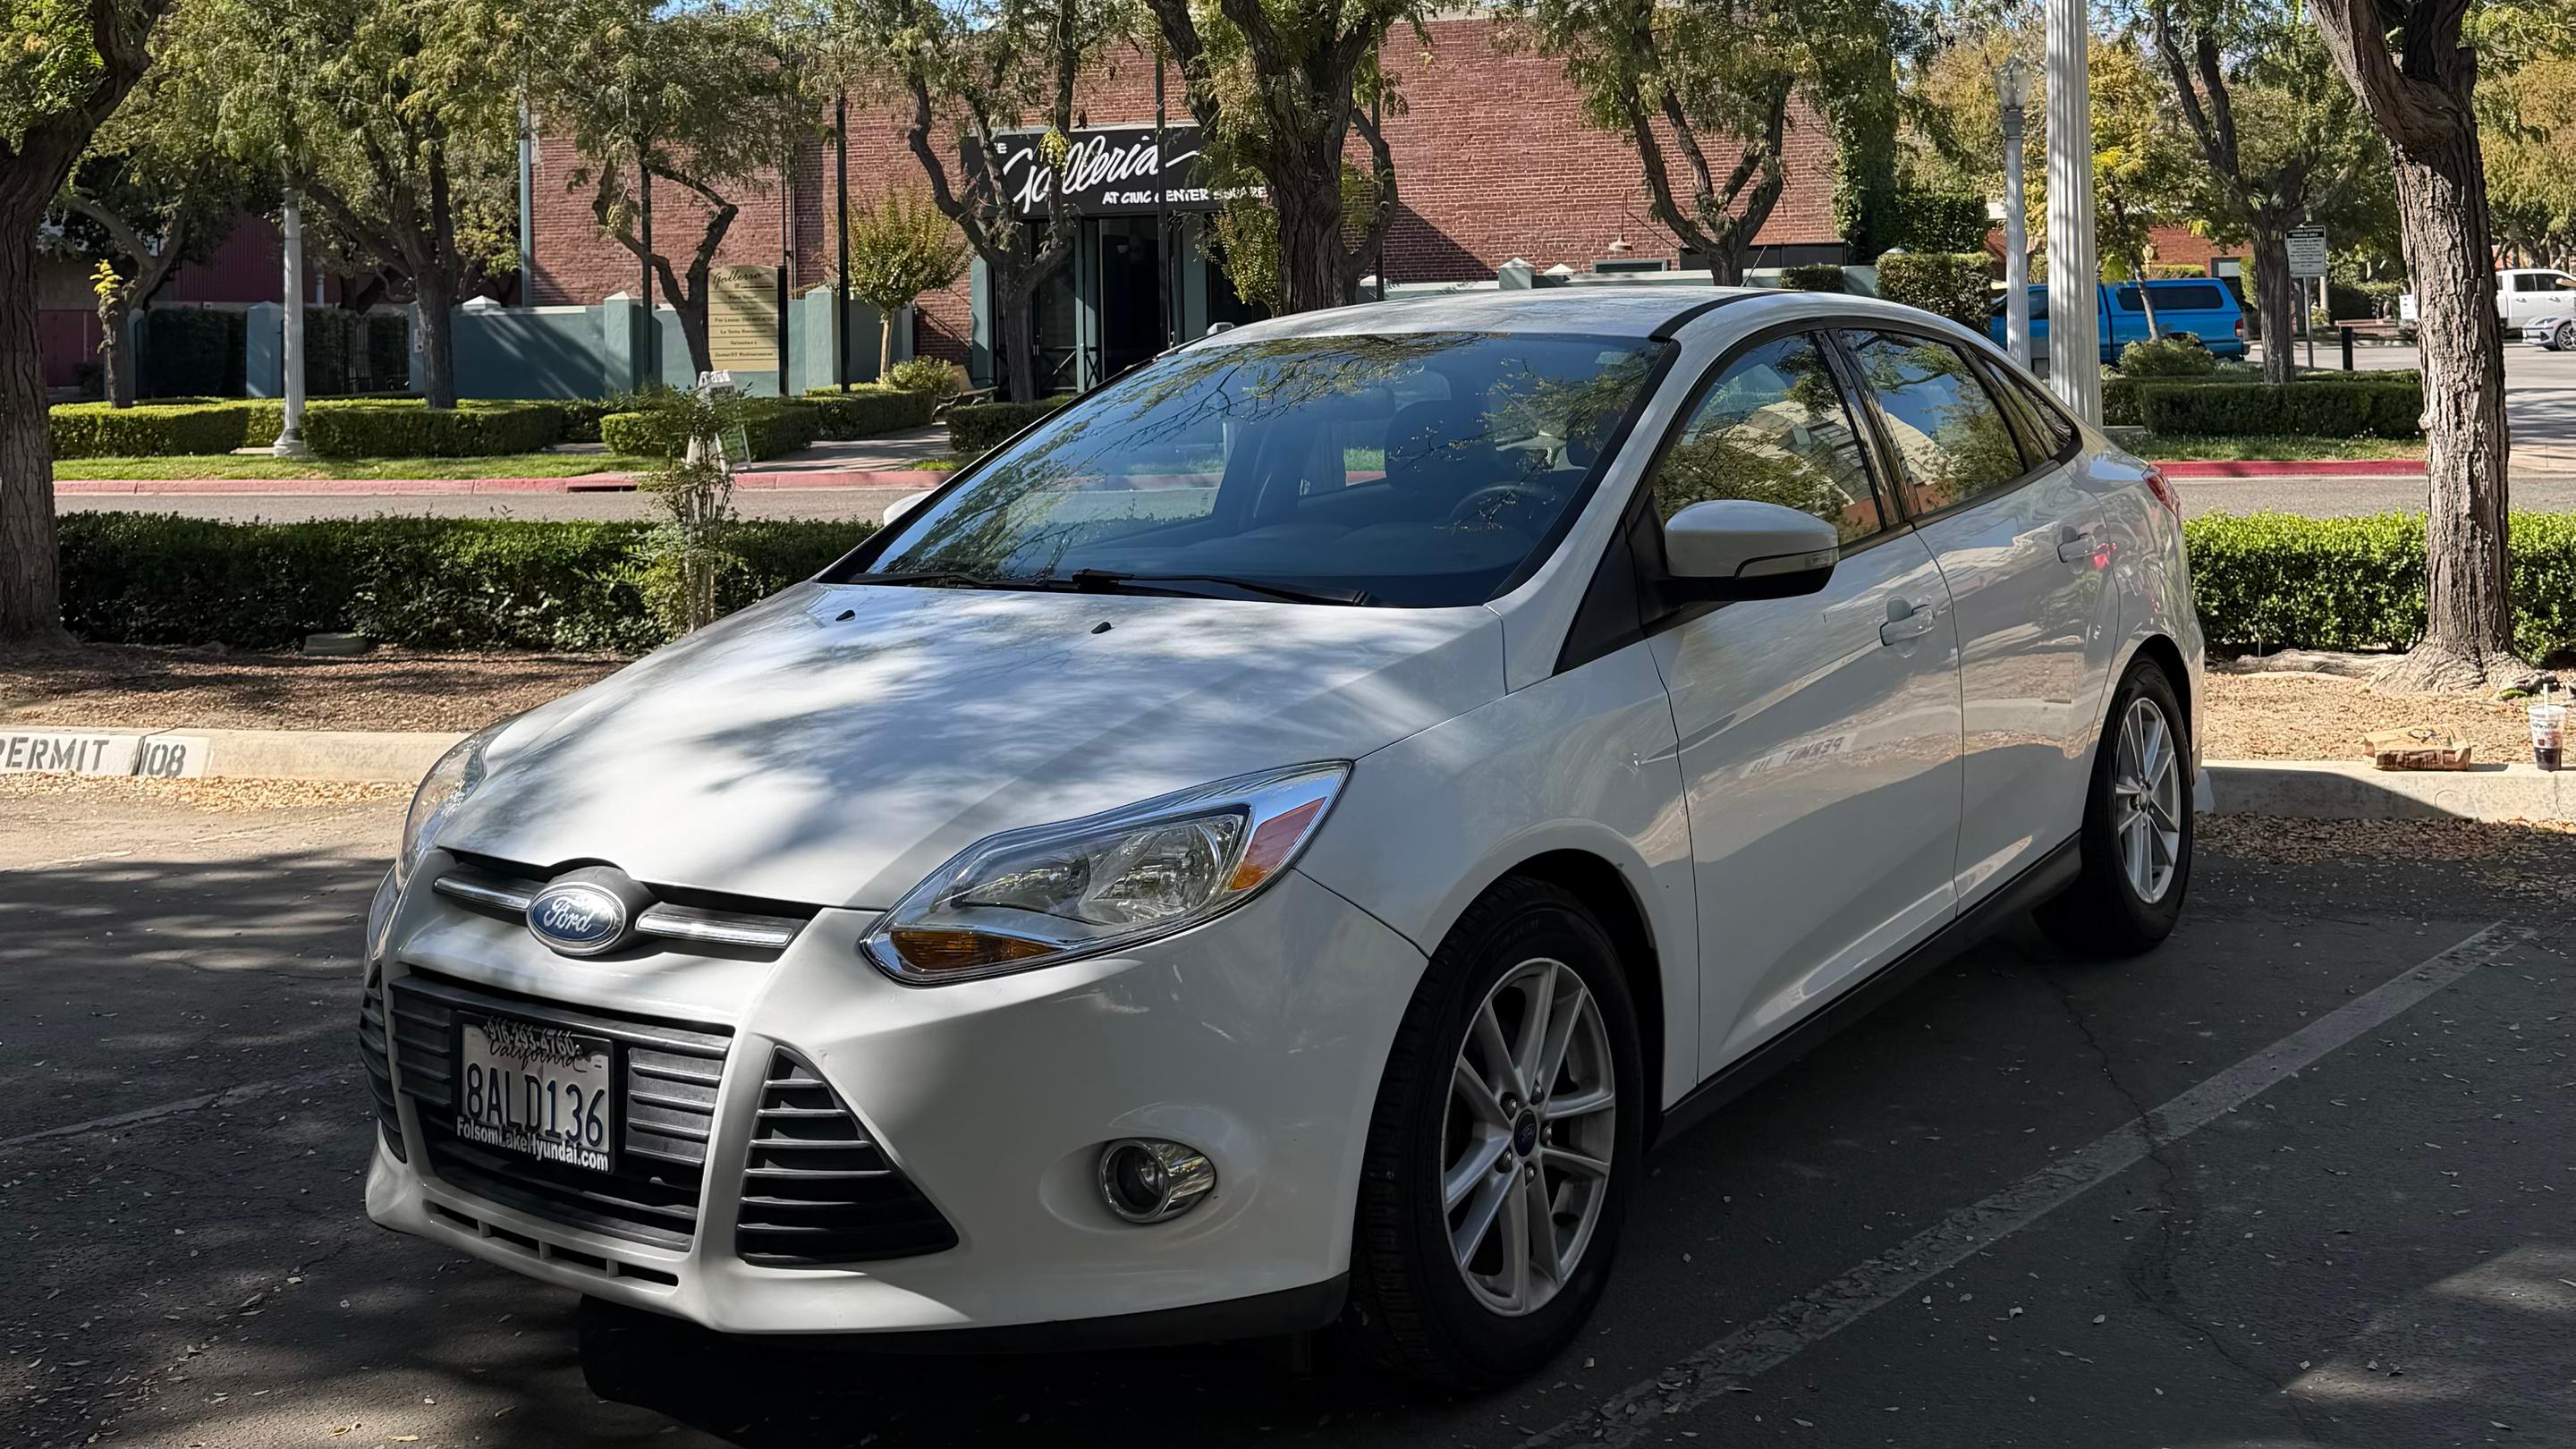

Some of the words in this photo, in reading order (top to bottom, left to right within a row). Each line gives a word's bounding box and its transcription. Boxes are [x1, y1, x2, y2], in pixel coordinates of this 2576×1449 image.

[1102, 191, 1119, 205] AT
[1120, 191, 1152, 204] CIVIC
[0, 736, 110, 771] ERMIT
[543, 895, 595, 932] Ford
[466, 1063, 606, 1147] 8ALD136
[456, 1116, 609, 1172] FolsomLakeHyundai.com
